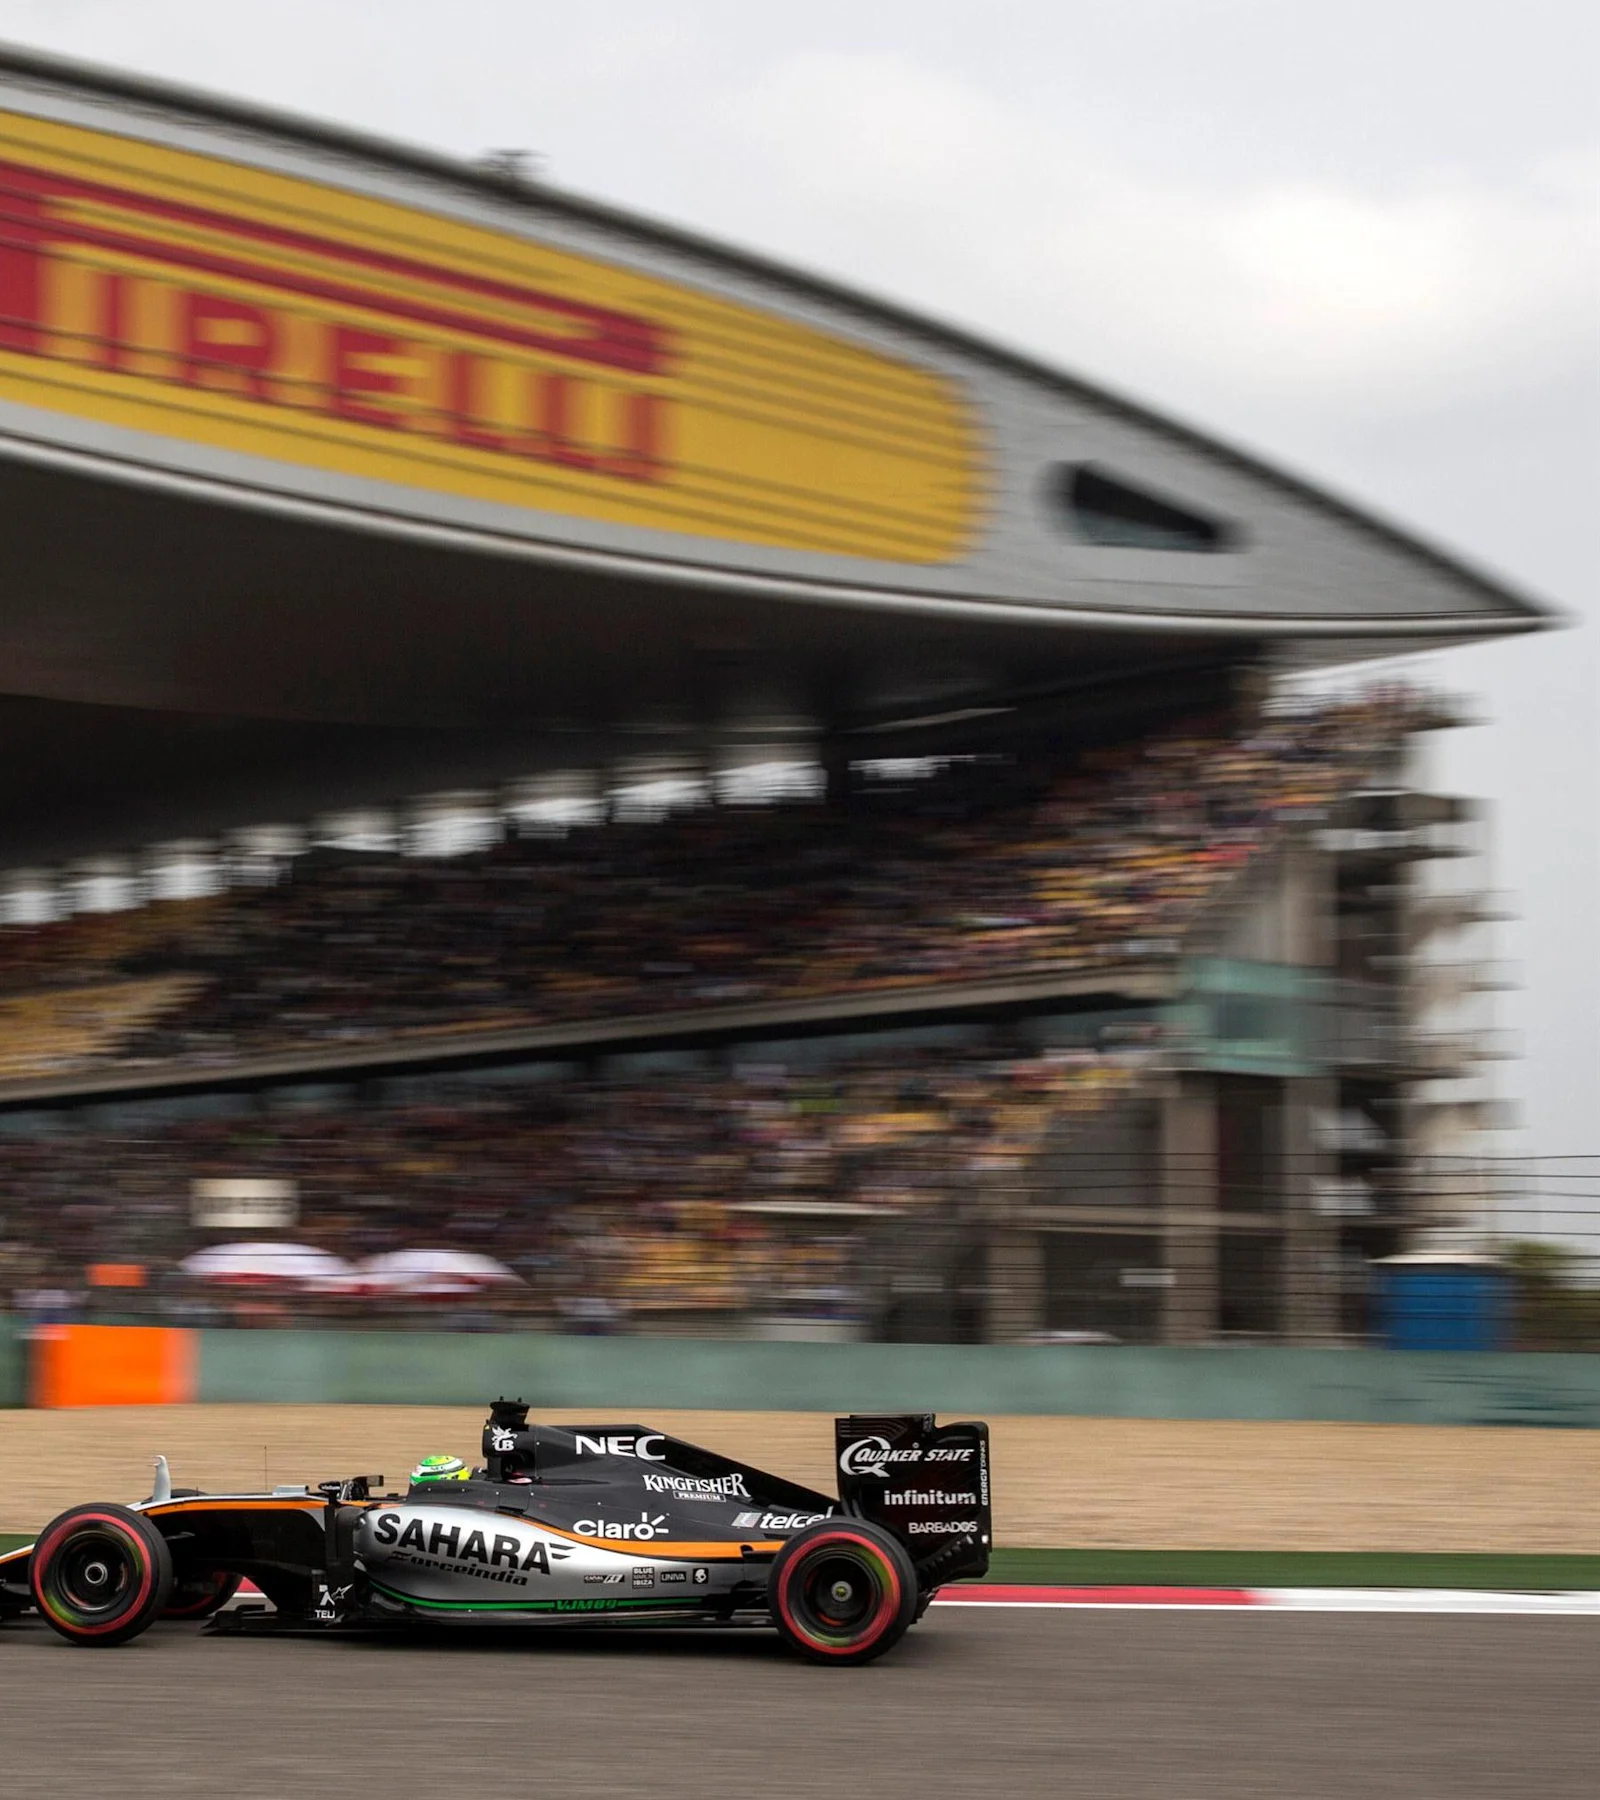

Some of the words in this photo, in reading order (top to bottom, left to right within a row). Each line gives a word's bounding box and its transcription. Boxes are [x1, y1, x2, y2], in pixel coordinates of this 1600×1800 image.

[576, 1435, 665, 1460] NEC
[924, 1449, 974, 1461] STATE
[642, 1473, 751, 1498] KINGFISHER
[678, 1492, 721, 1501] PREMIUM
[884, 1489, 976, 1505] infinitum
[573, 1519, 654, 1540] Claro
[908, 1521, 978, 1534] BARBADOS
[375, 1514, 551, 1575] SAHARA
[661, 1573, 685, 1581] UNIVA
